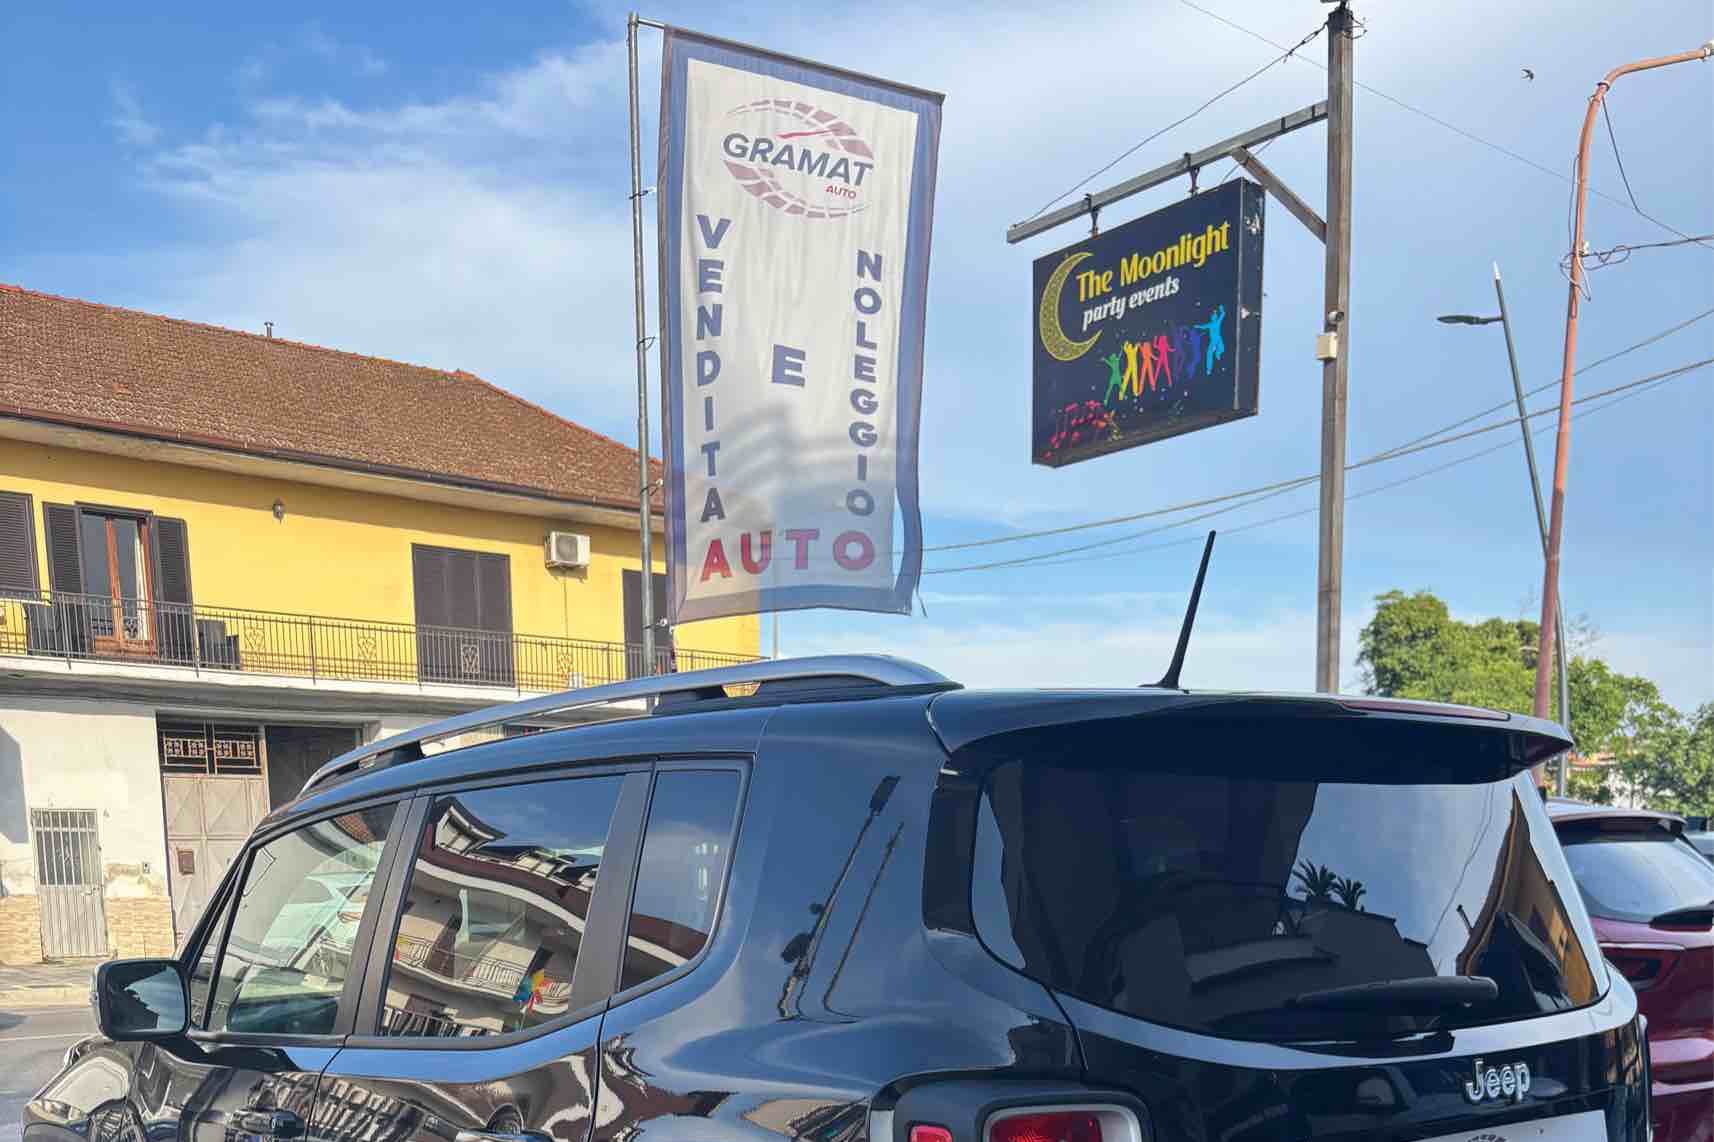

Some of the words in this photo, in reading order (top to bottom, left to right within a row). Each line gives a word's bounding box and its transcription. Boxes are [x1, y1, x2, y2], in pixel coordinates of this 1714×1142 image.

[723, 133, 874, 186] GRAMAT
[826, 185, 857, 199] AUTO
[1076, 270, 1112, 302] The
[1120, 221, 1230, 287] Moonlight
[1082, 295, 1126, 331] party
[1128, 276, 1180, 308] events
[696, 214, 731, 522] VENDITA
[771, 344, 806, 388] E
[846, 249, 882, 517] NOLEGGIO
[700, 529, 876, 582] AUTO
[1465, 1058, 1531, 1100] Jeep
